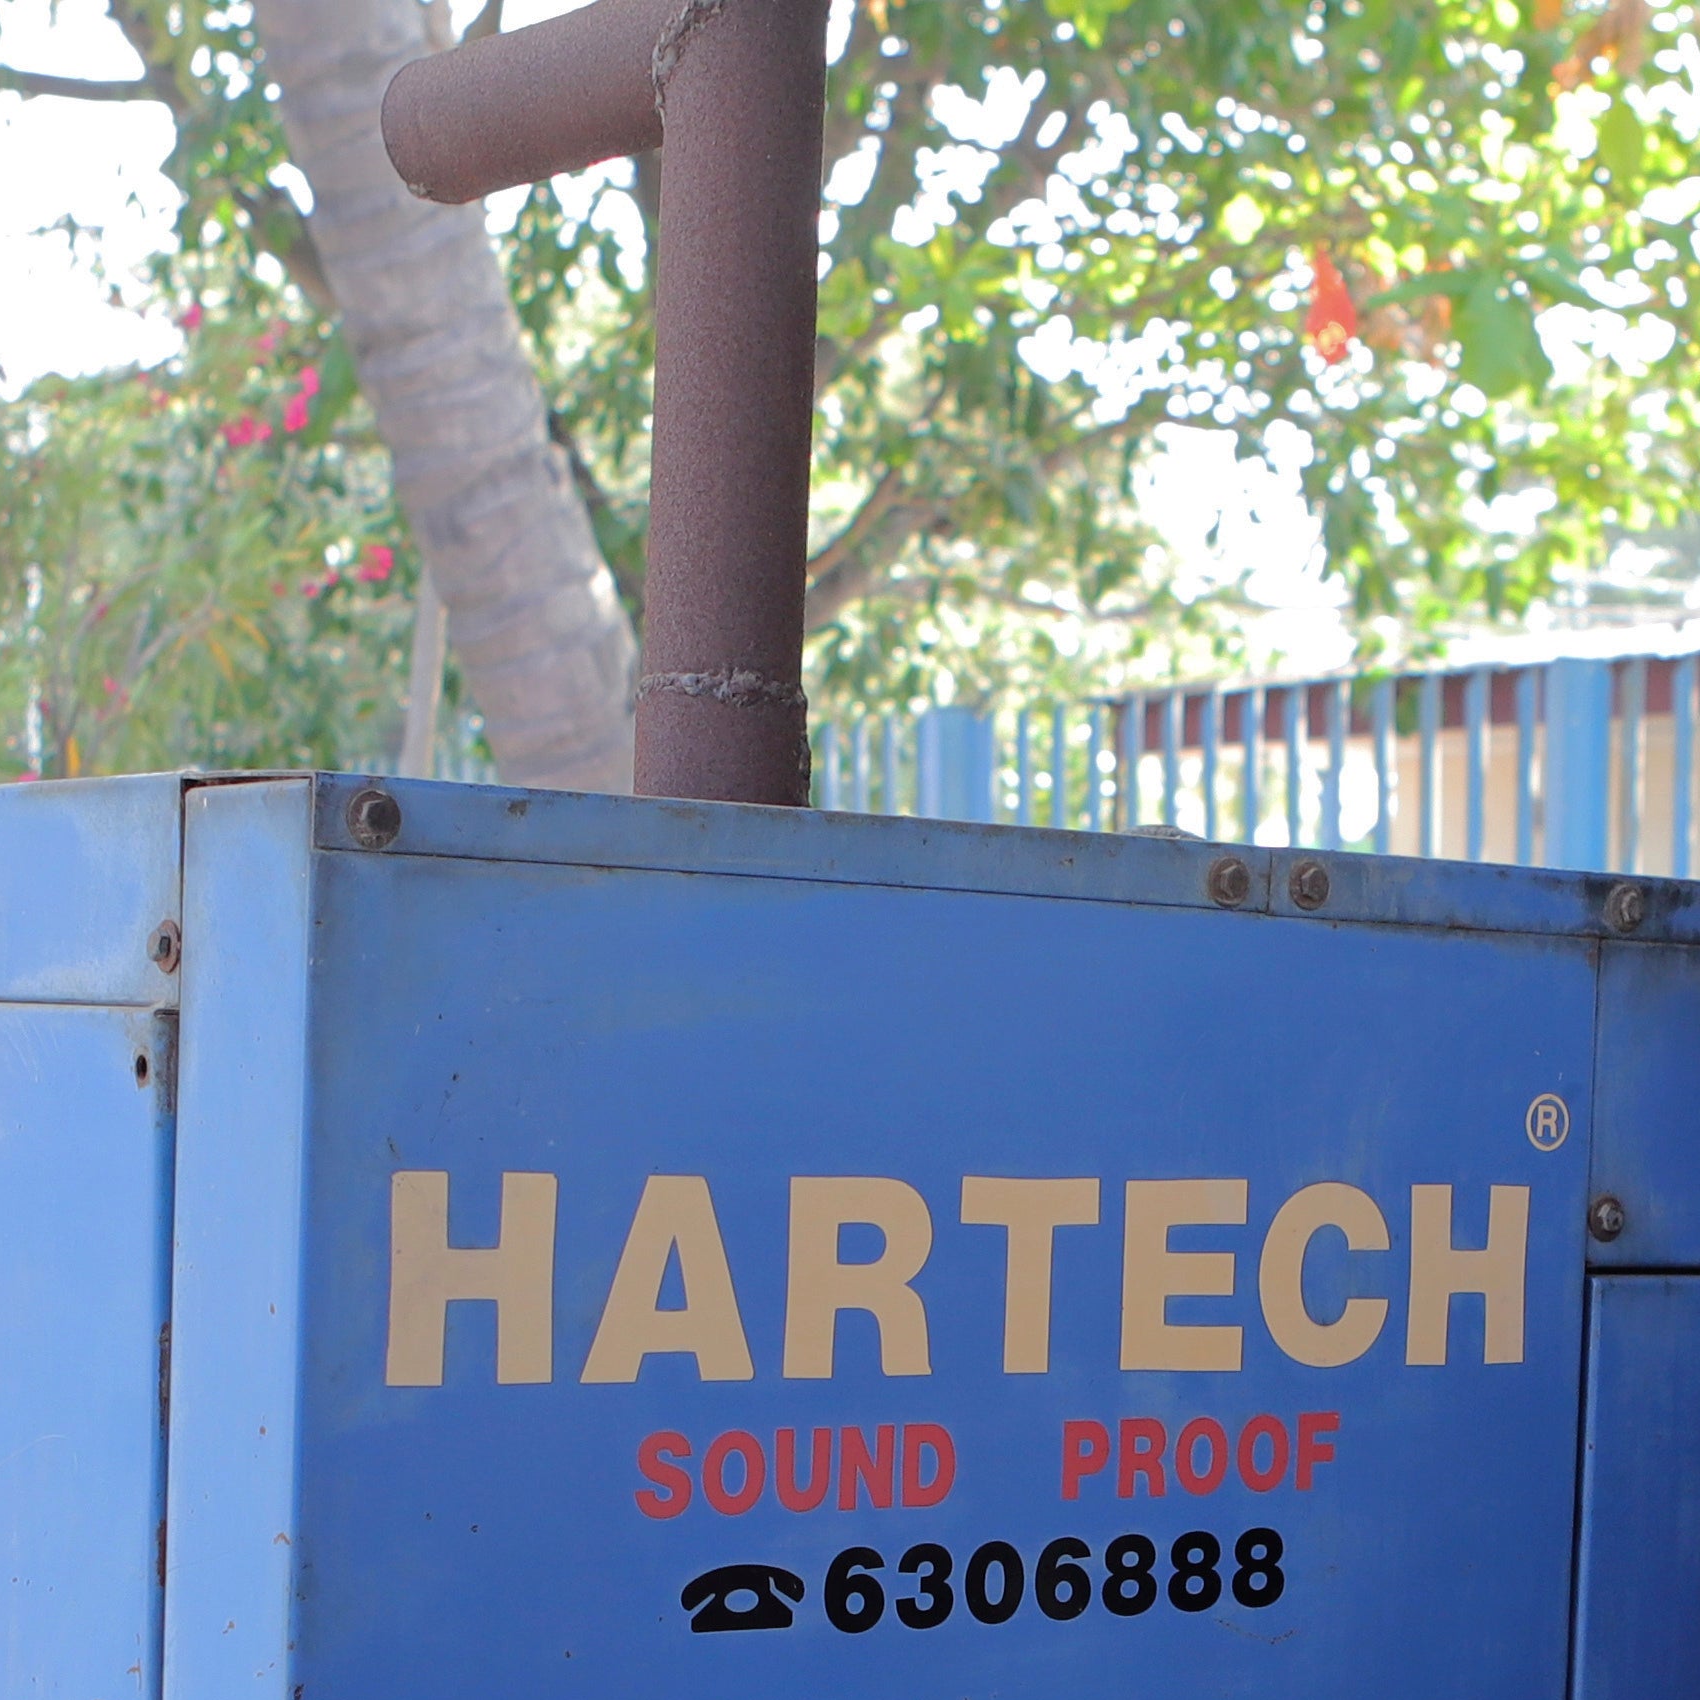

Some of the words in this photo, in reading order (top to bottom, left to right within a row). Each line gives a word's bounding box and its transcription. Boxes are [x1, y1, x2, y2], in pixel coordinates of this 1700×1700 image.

[386, 1171, 1529, 1385] HARTECH
[635, 1423, 956, 1519] SOUND
[1062, 1412, 1339, 1500] PROOF
[825, 1528, 1284, 1633] 6306888
